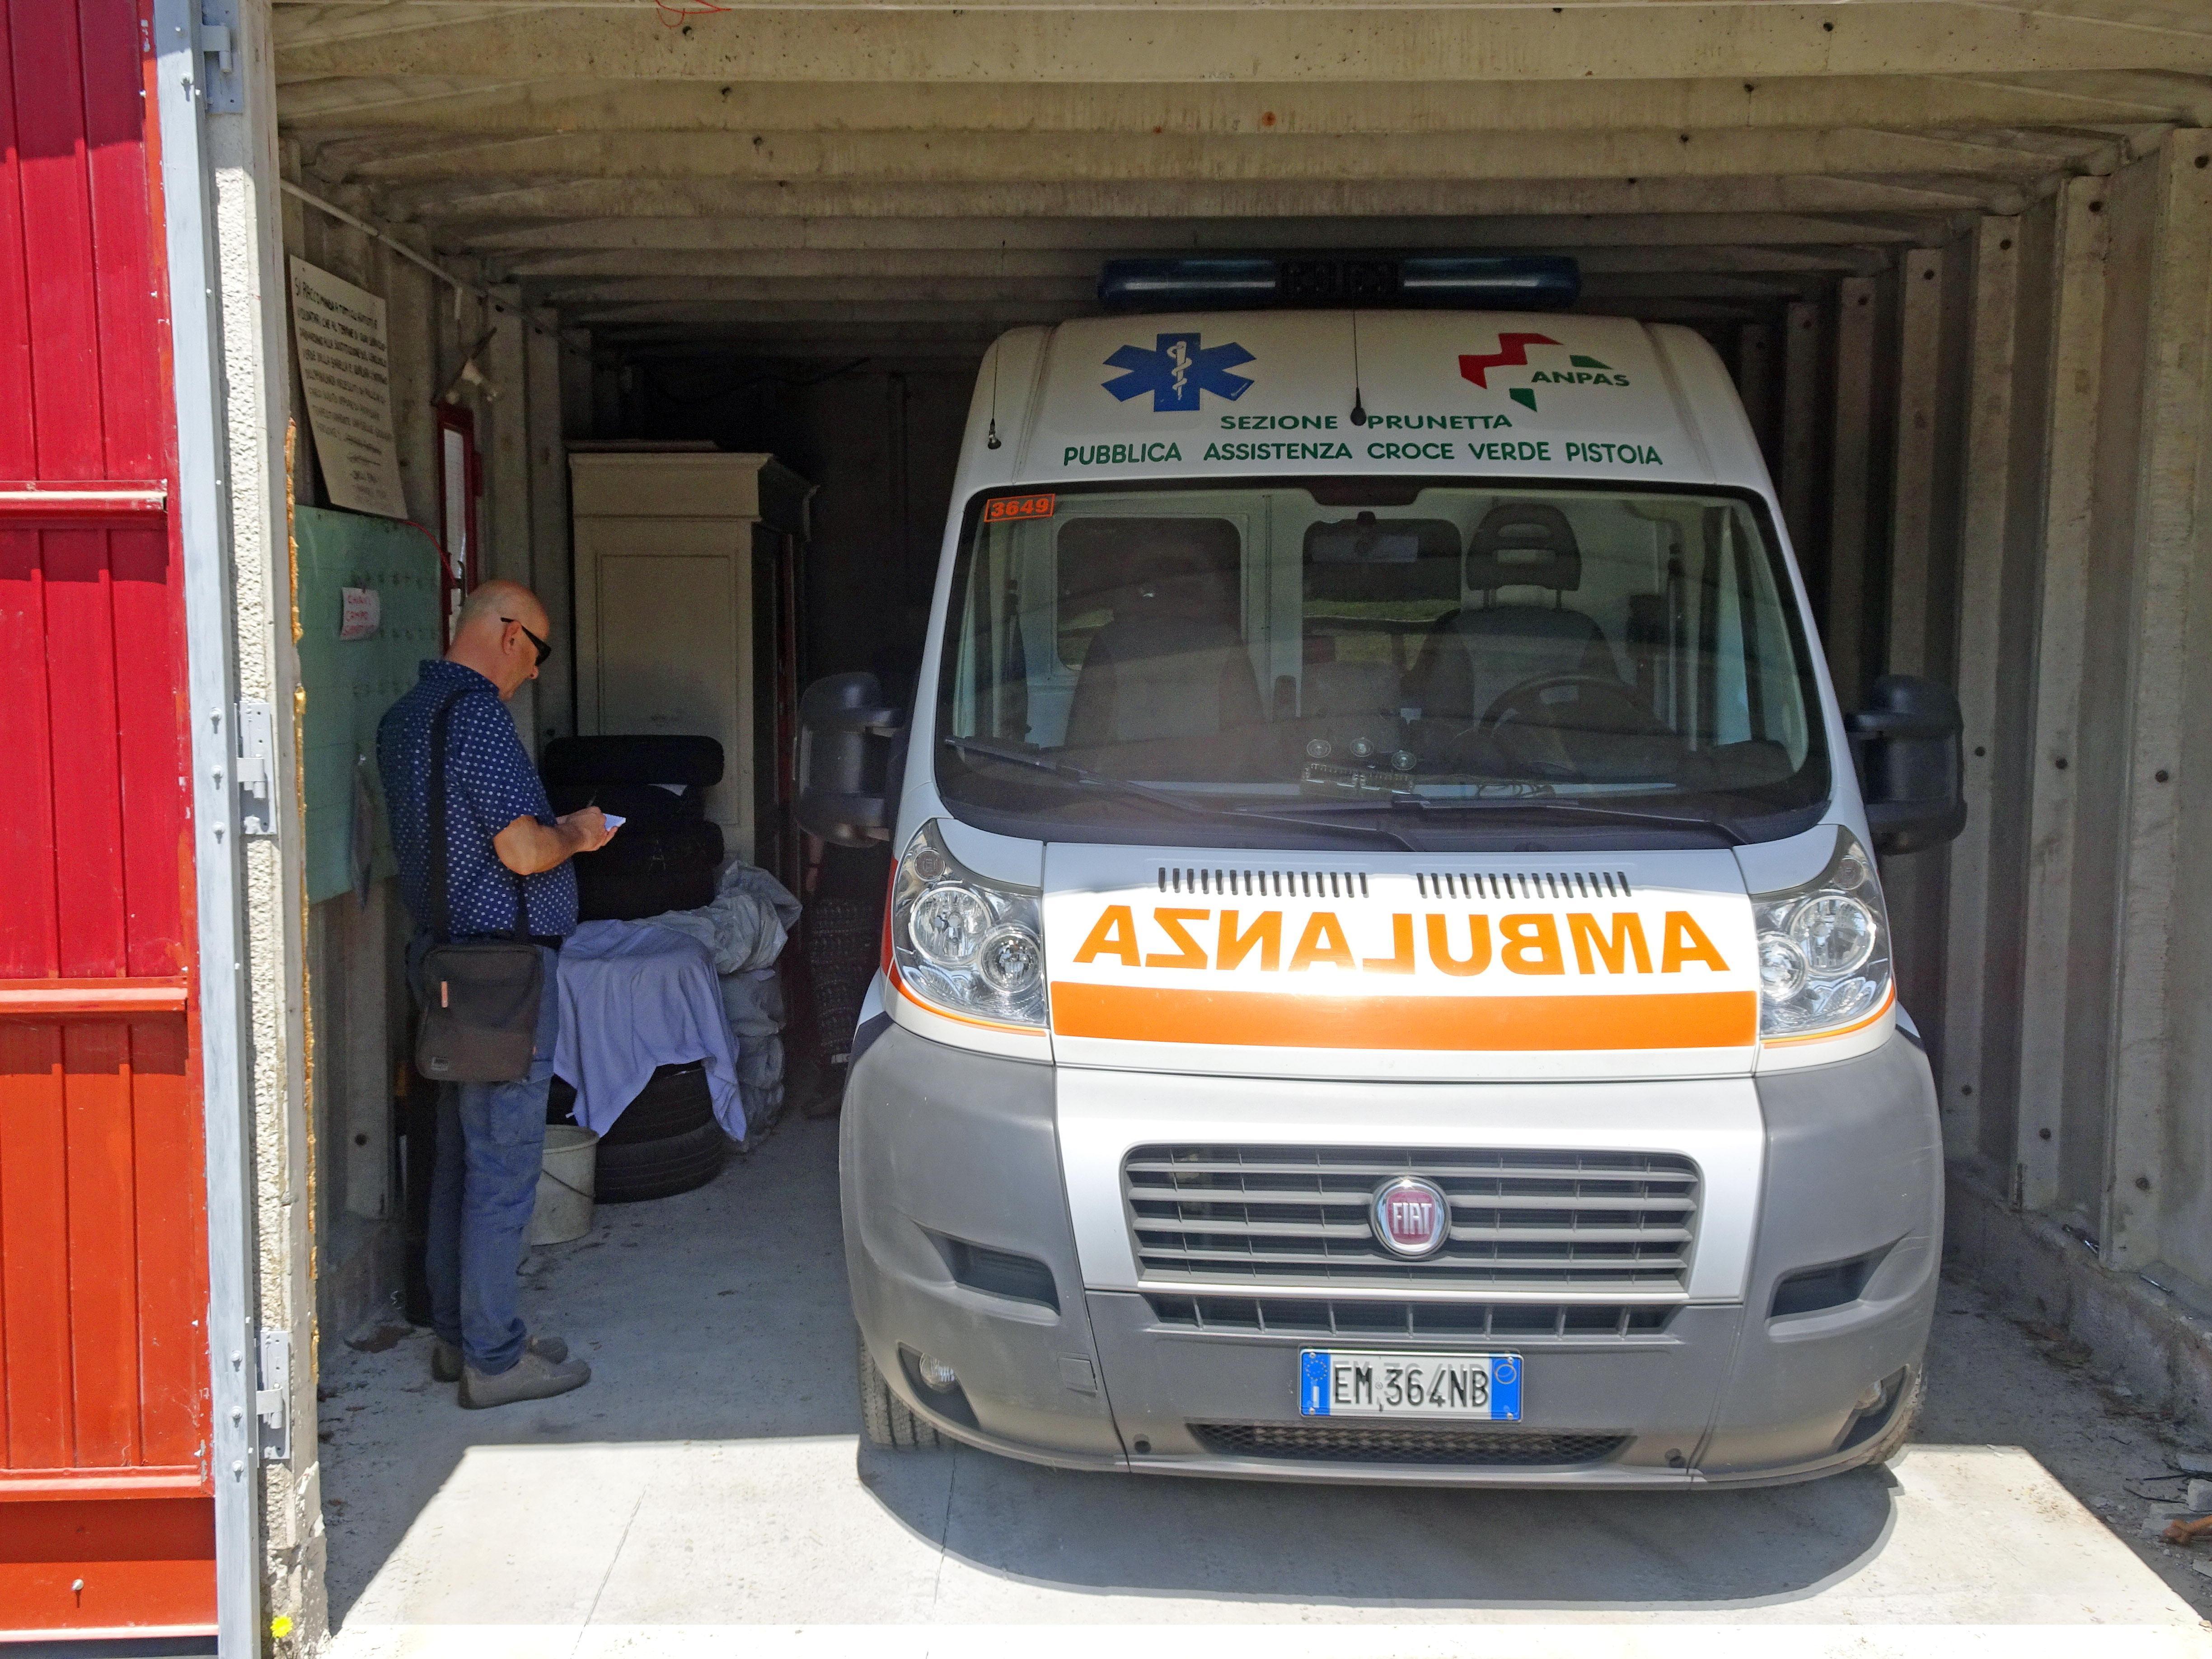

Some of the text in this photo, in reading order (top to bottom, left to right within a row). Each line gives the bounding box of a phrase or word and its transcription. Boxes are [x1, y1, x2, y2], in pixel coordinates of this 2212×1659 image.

[1531, 370, 1630, 387] ANPAS
[1221, 414, 1513, 430] SEZIONE PRUNETTA
[1064, 441, 1663, 466] PUBBLICA ASSISTENZA CROCE VERDE PISTOIA
[991, 498, 1049, 517] 3649
[1392, 1202, 1432, 1235] FIAT
